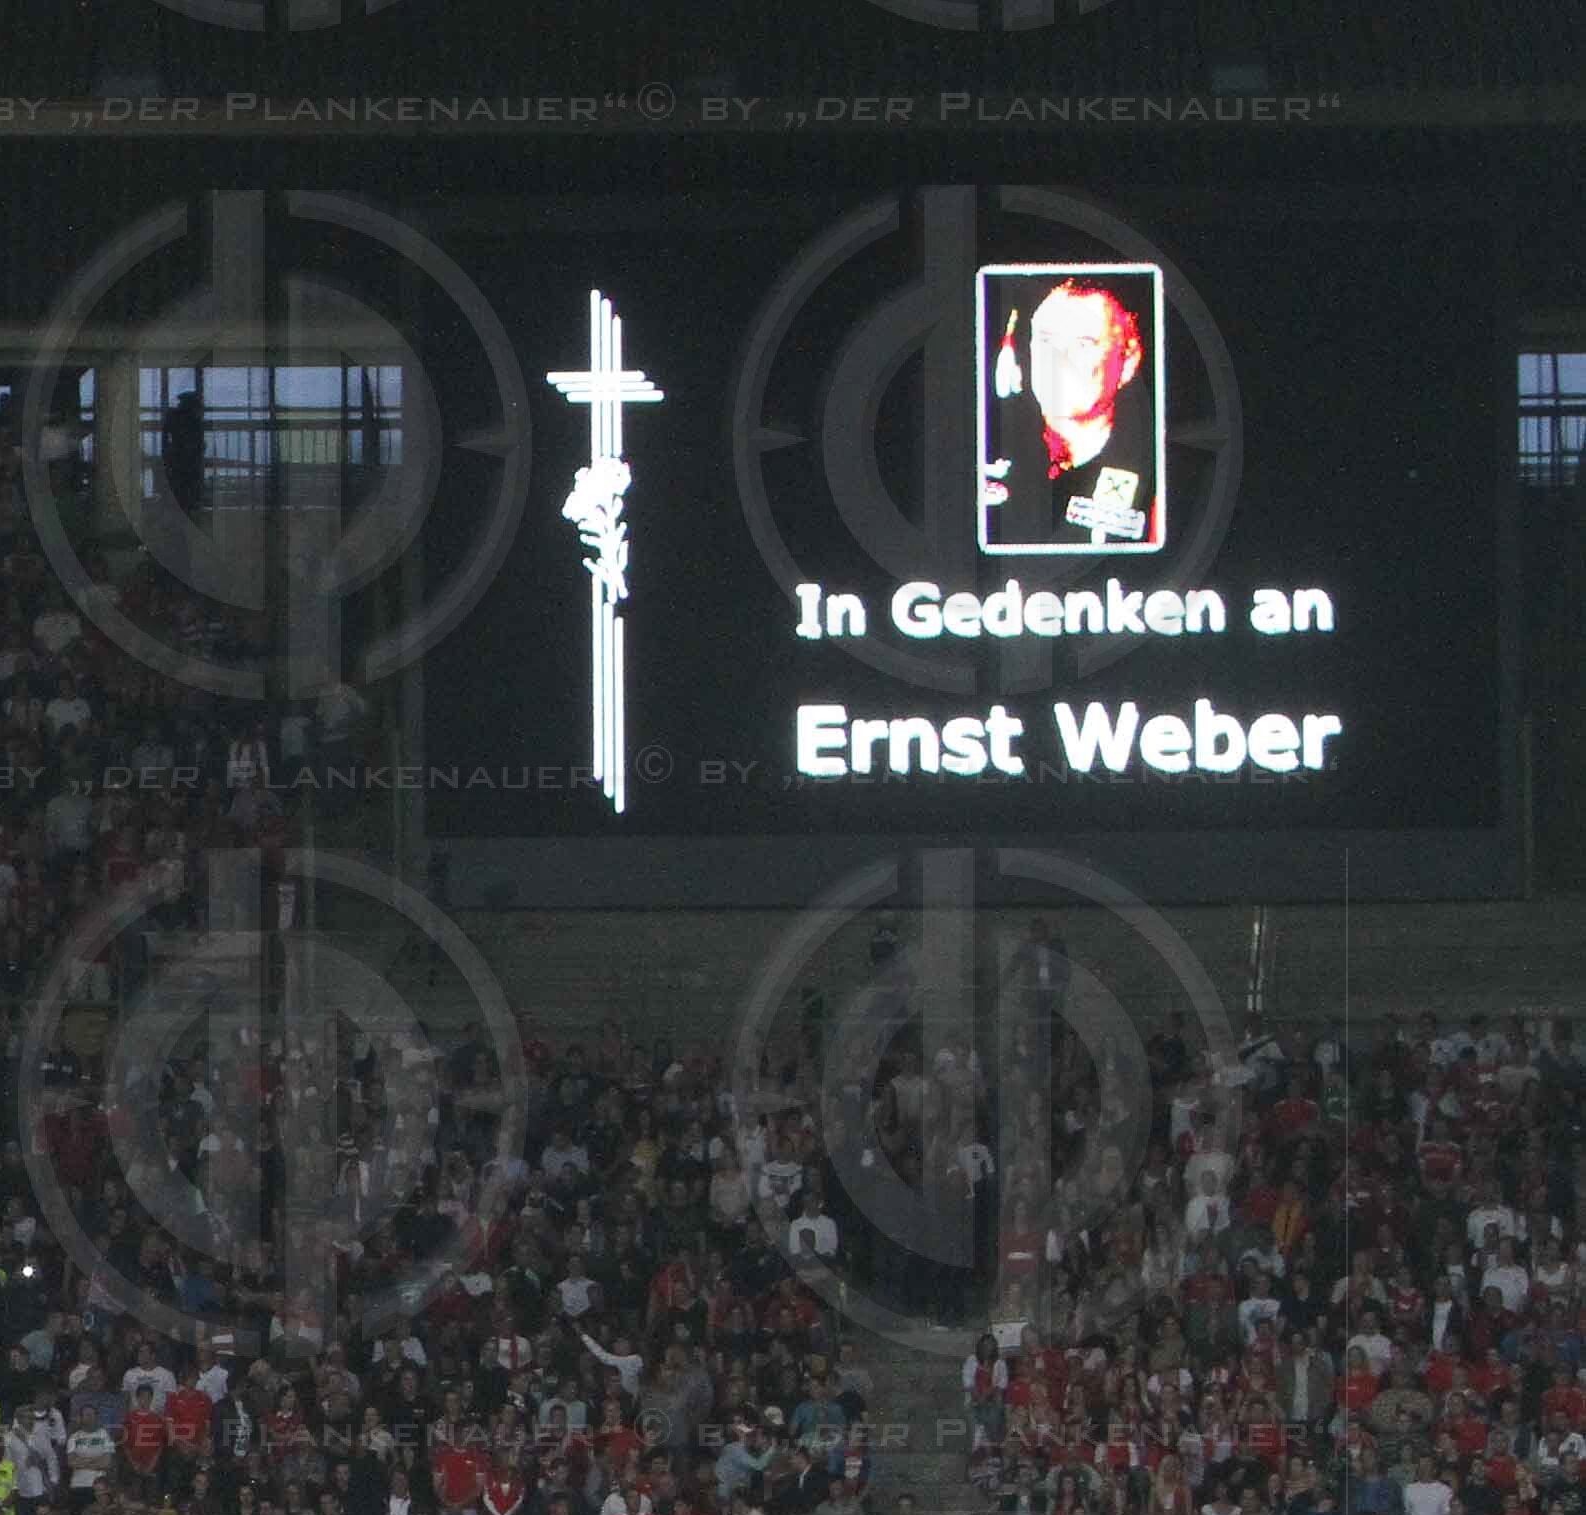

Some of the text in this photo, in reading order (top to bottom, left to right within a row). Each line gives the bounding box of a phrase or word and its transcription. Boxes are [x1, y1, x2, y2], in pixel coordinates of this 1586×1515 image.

[796, 578, 1333, 637] In Gedenken an
[797, 698, 1341, 775] Ernst Weber
